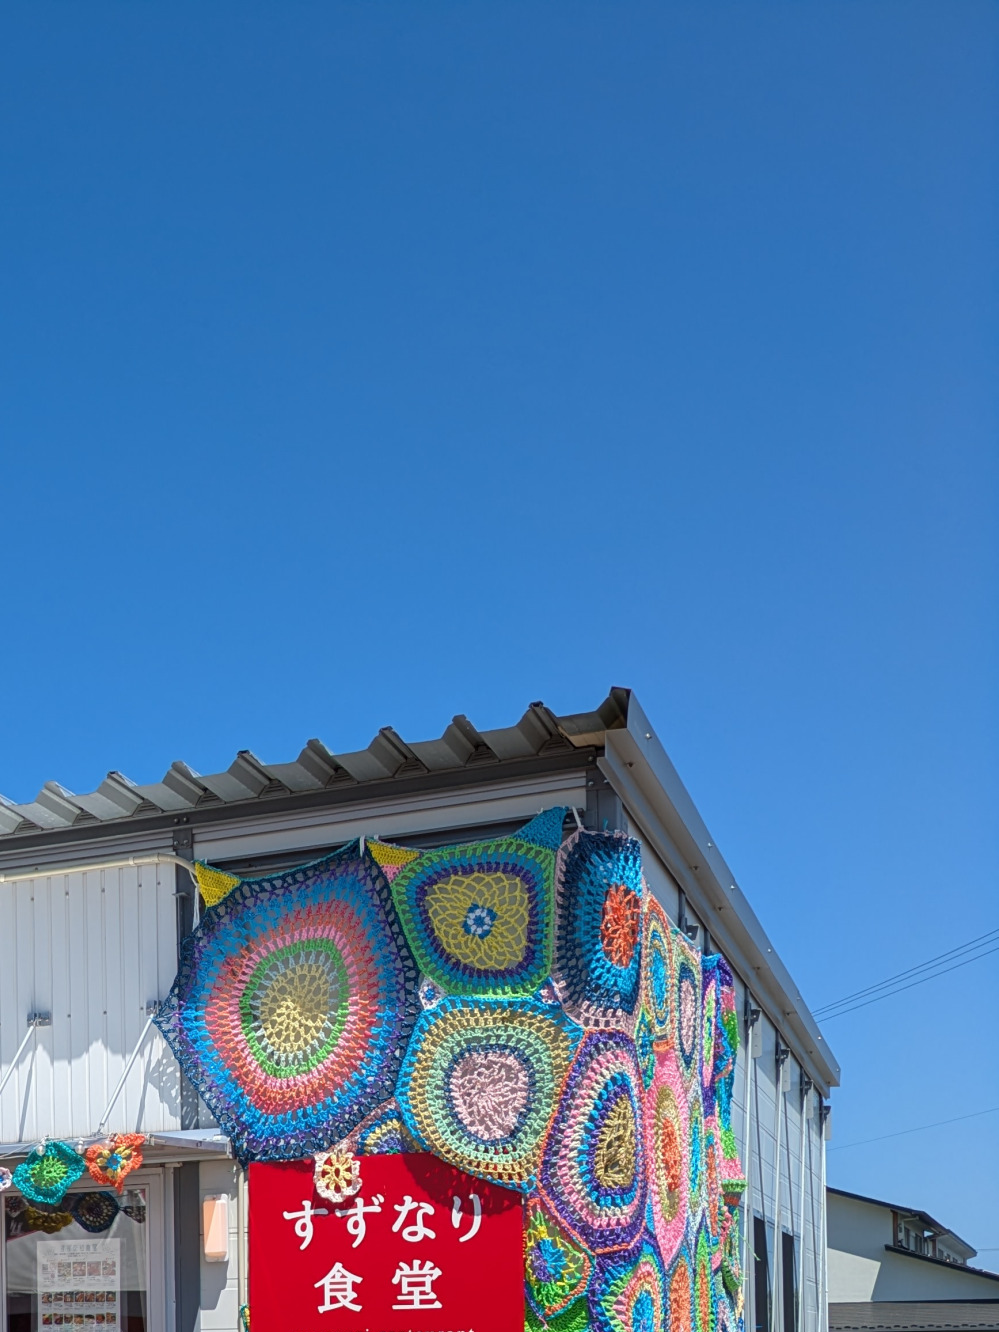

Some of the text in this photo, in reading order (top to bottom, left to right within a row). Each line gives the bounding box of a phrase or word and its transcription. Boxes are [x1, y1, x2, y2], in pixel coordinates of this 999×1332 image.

[282, 1193, 483, 1251] すずなり
[313, 1259, 443, 1314] 食堂
